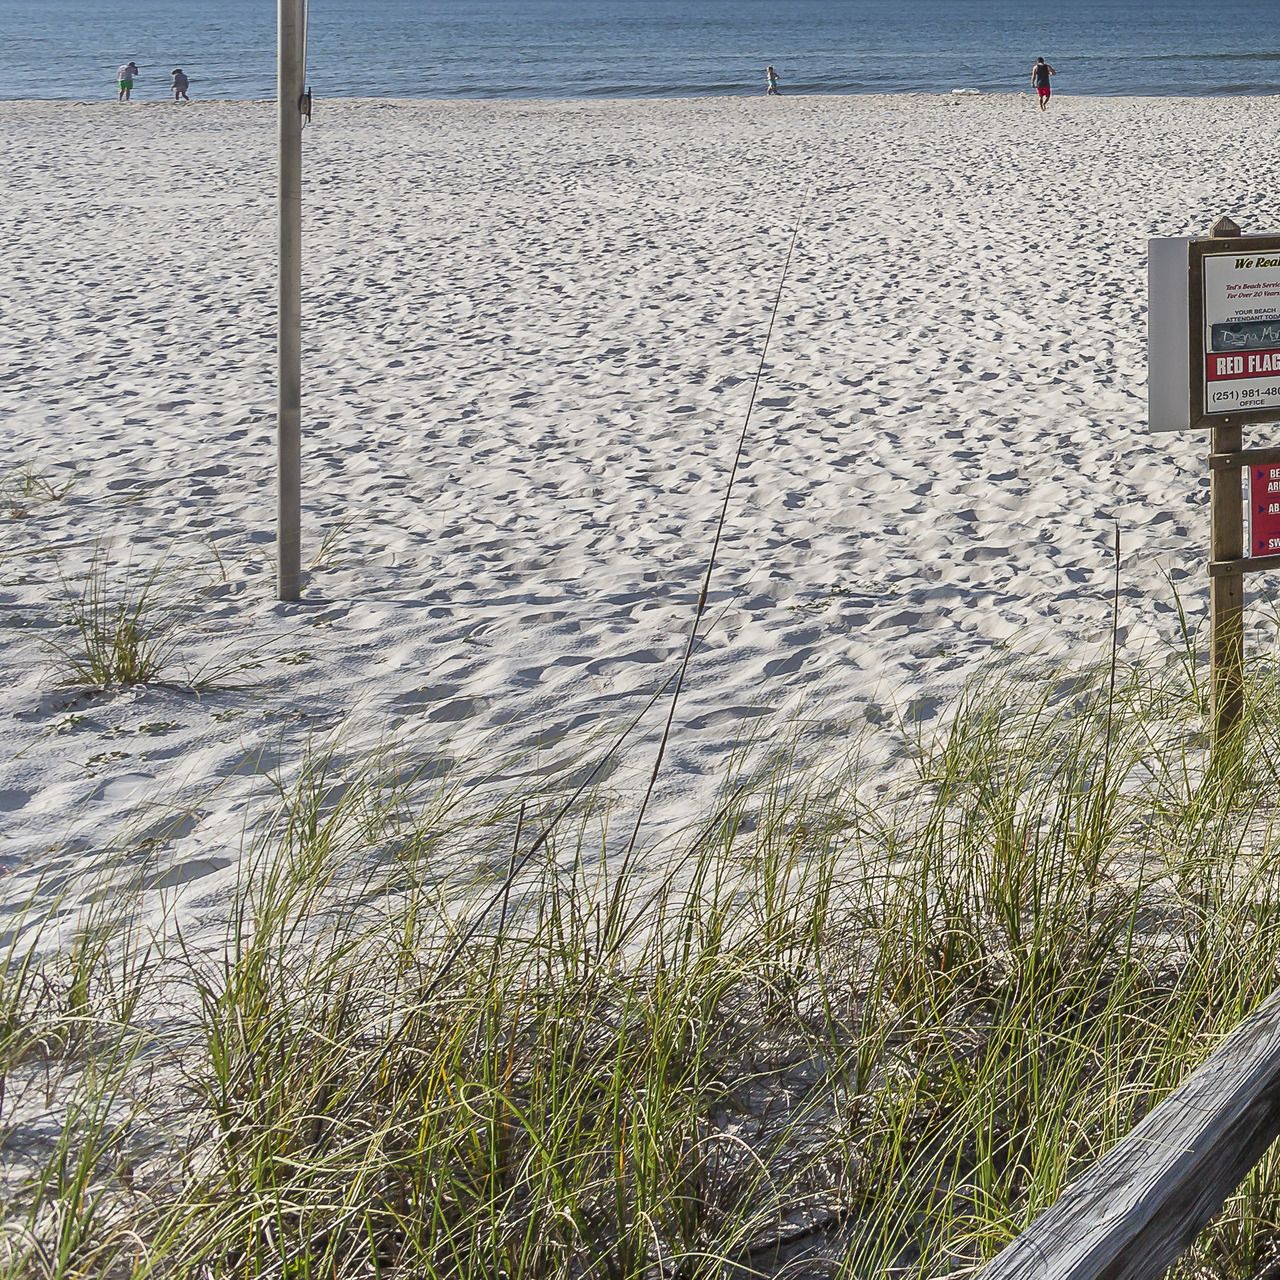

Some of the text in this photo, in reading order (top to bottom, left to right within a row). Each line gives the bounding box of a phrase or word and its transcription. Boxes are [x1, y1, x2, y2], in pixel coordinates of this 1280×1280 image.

[1234, 258, 1254, 269] We
[1216, 357, 1243, 375] RED
[1248, 354, 1280, 372] FLAG
[1212, 391, 1239, 403] (251)
